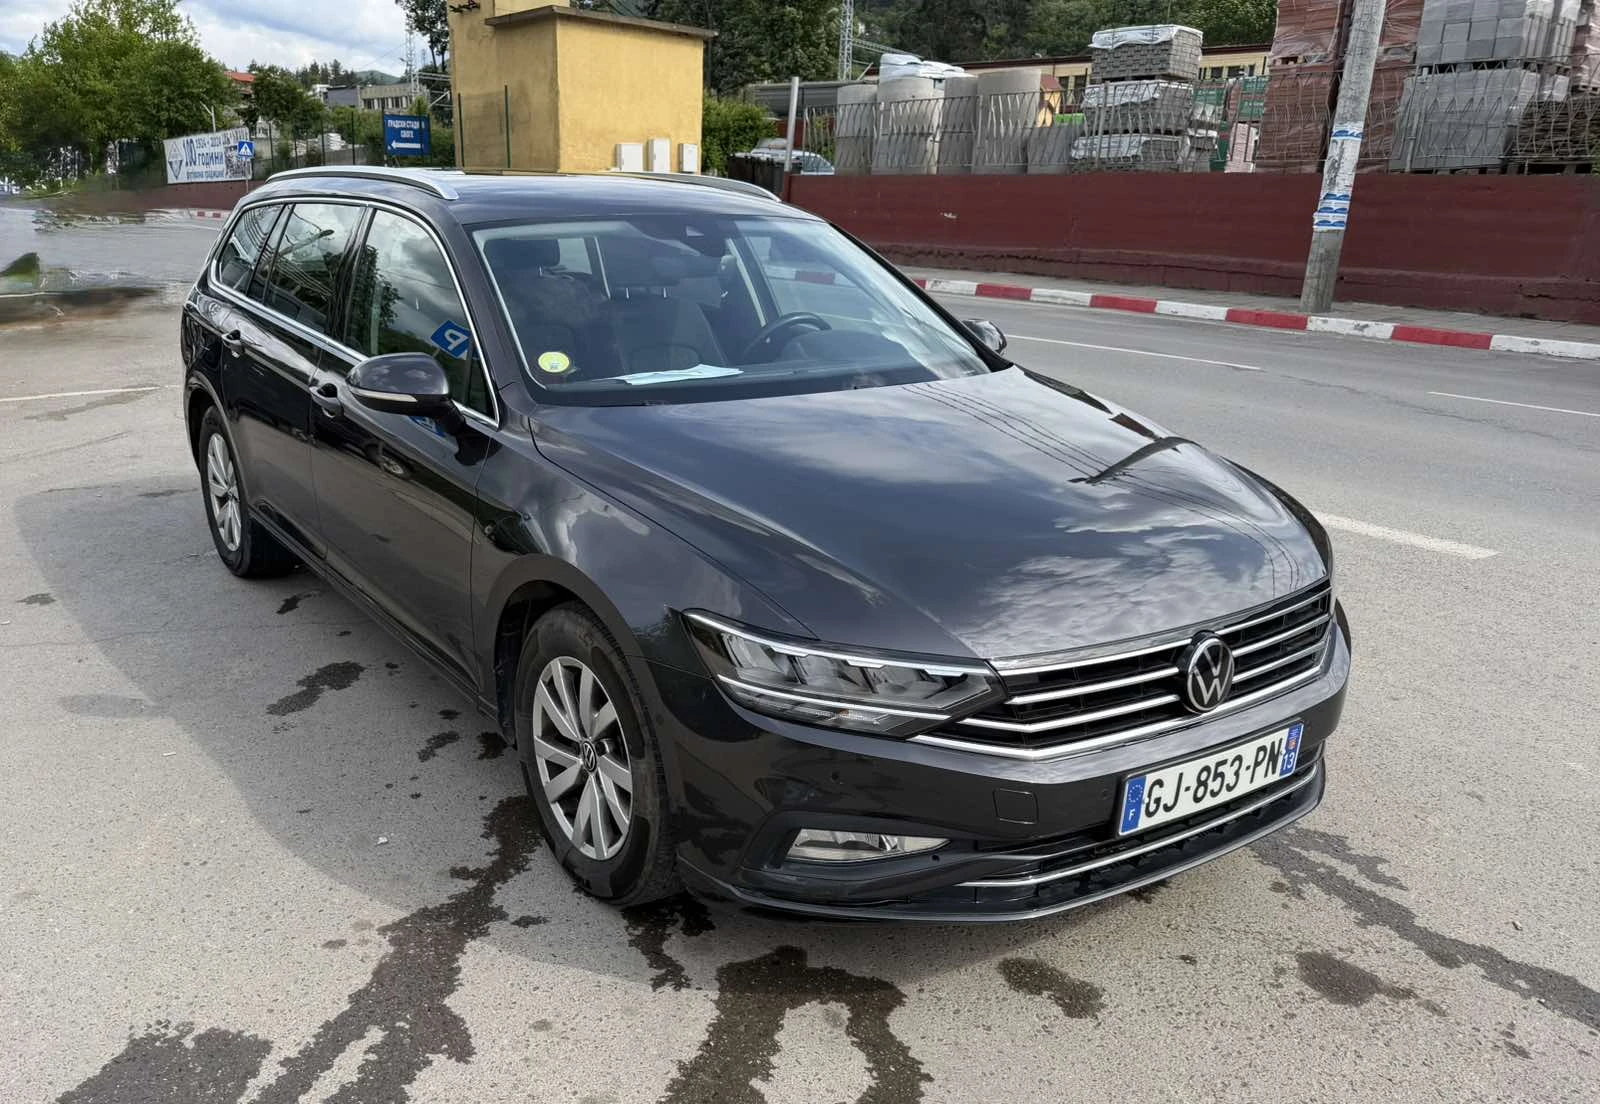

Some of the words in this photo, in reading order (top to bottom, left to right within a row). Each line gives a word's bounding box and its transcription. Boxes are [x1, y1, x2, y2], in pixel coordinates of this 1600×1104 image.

[1282, 752, 1294, 770] 13
[1144, 737, 1284, 819] GJ-853-PN
[1128, 808, 1136, 821] F
